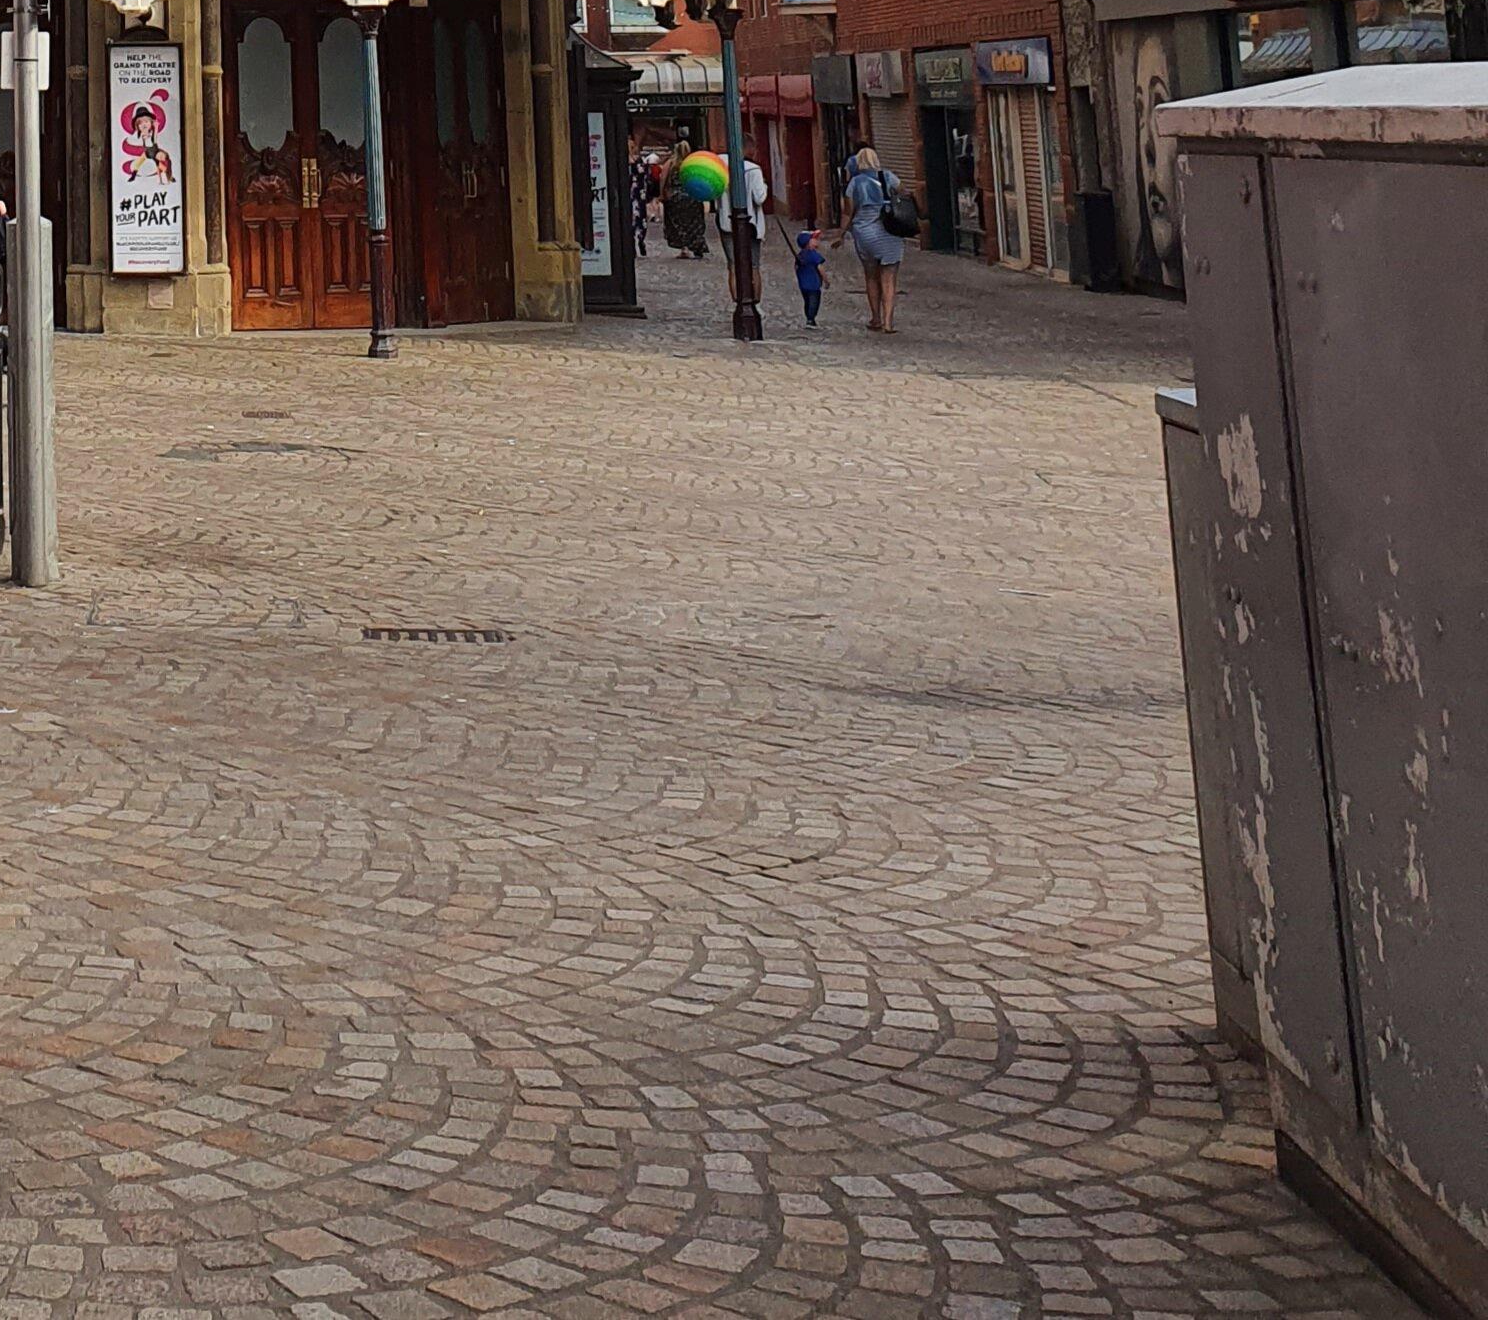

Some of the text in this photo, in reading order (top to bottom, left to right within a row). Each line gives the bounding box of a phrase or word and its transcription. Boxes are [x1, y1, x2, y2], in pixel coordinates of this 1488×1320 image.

[142, 61, 176, 69] THEATRE
[115, 205, 181, 227] YOUR PART
